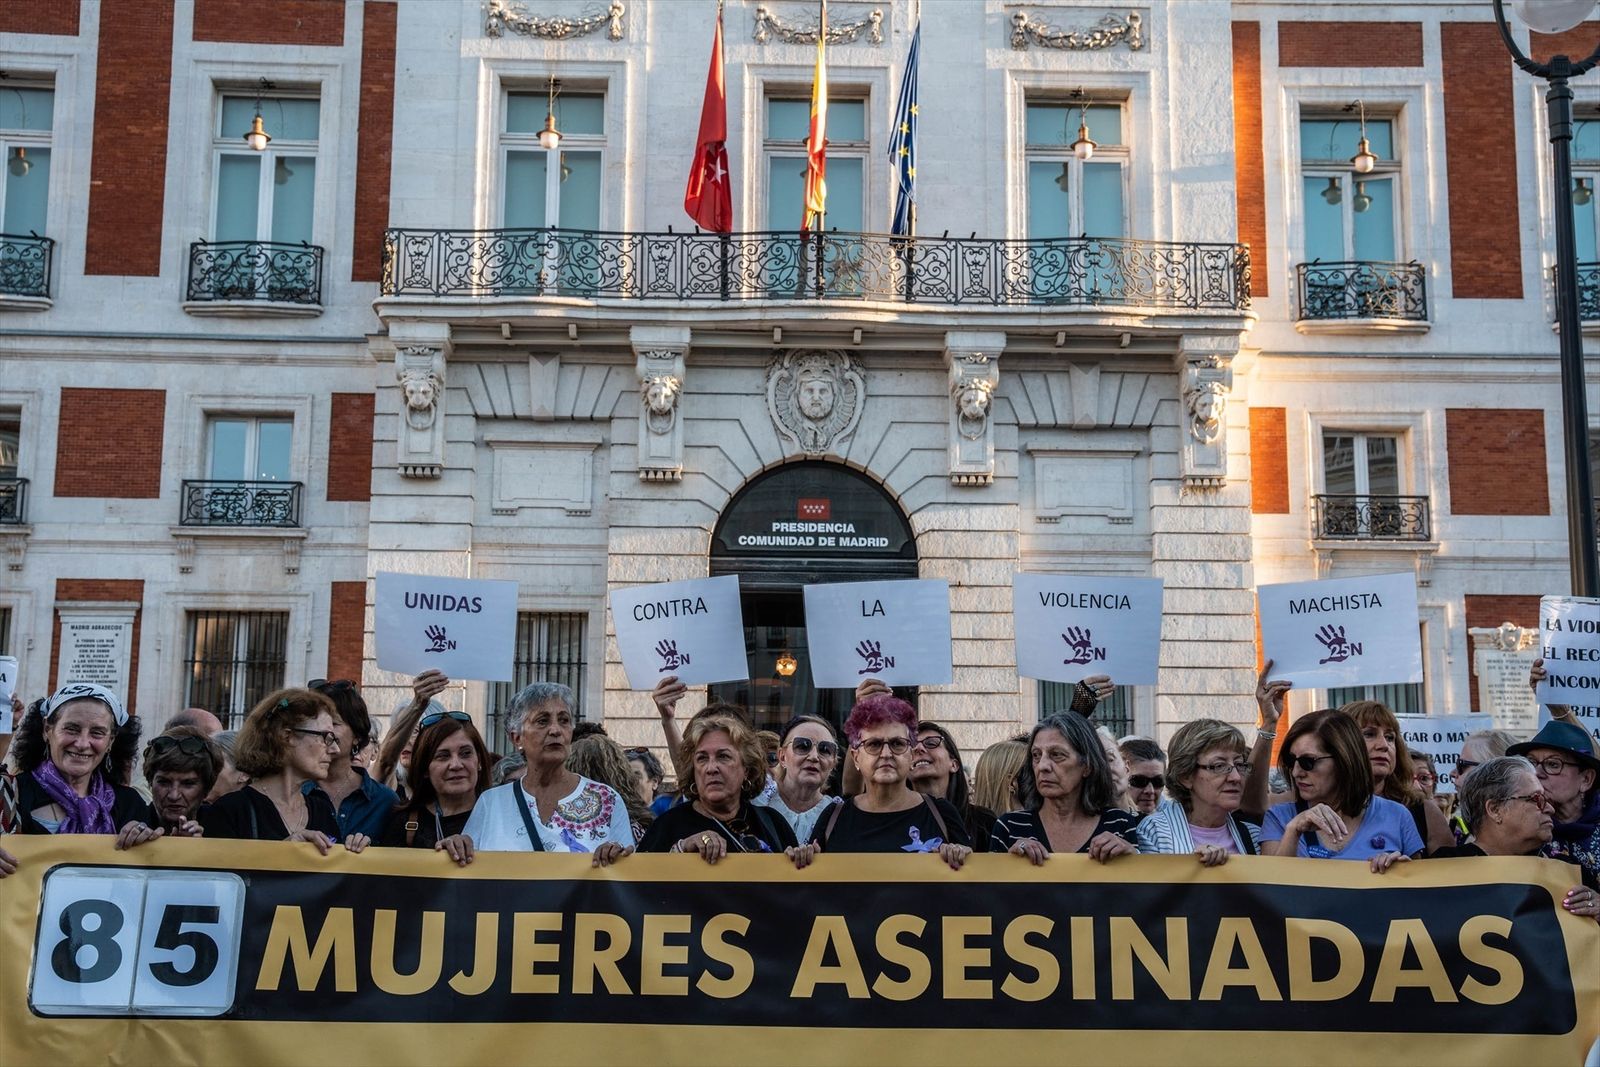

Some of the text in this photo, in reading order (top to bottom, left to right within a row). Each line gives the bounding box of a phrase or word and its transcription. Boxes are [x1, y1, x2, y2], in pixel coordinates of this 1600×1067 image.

[772, 522, 855, 533] PRESIDENCIA
[738, 535, 889, 548] COMUNIDAD DE MADRID
[404, 591, 482, 614] UNIDAS
[862, 600, 885, 617] LA
[1039, 591, 1131, 610] VIOLENCIA
[1289, 592, 1382, 615] MACHISTA
[633, 597, 708, 622] CONTRA
[1546, 618, 1562, 632] LA
[1543, 646, 1561, 660] EL
[1401, 731, 1429, 743] GAR
[1432, 732, 1442, 743] O
[50, 899, 1525, 1006] 85 MUJERES ASESINADAS
